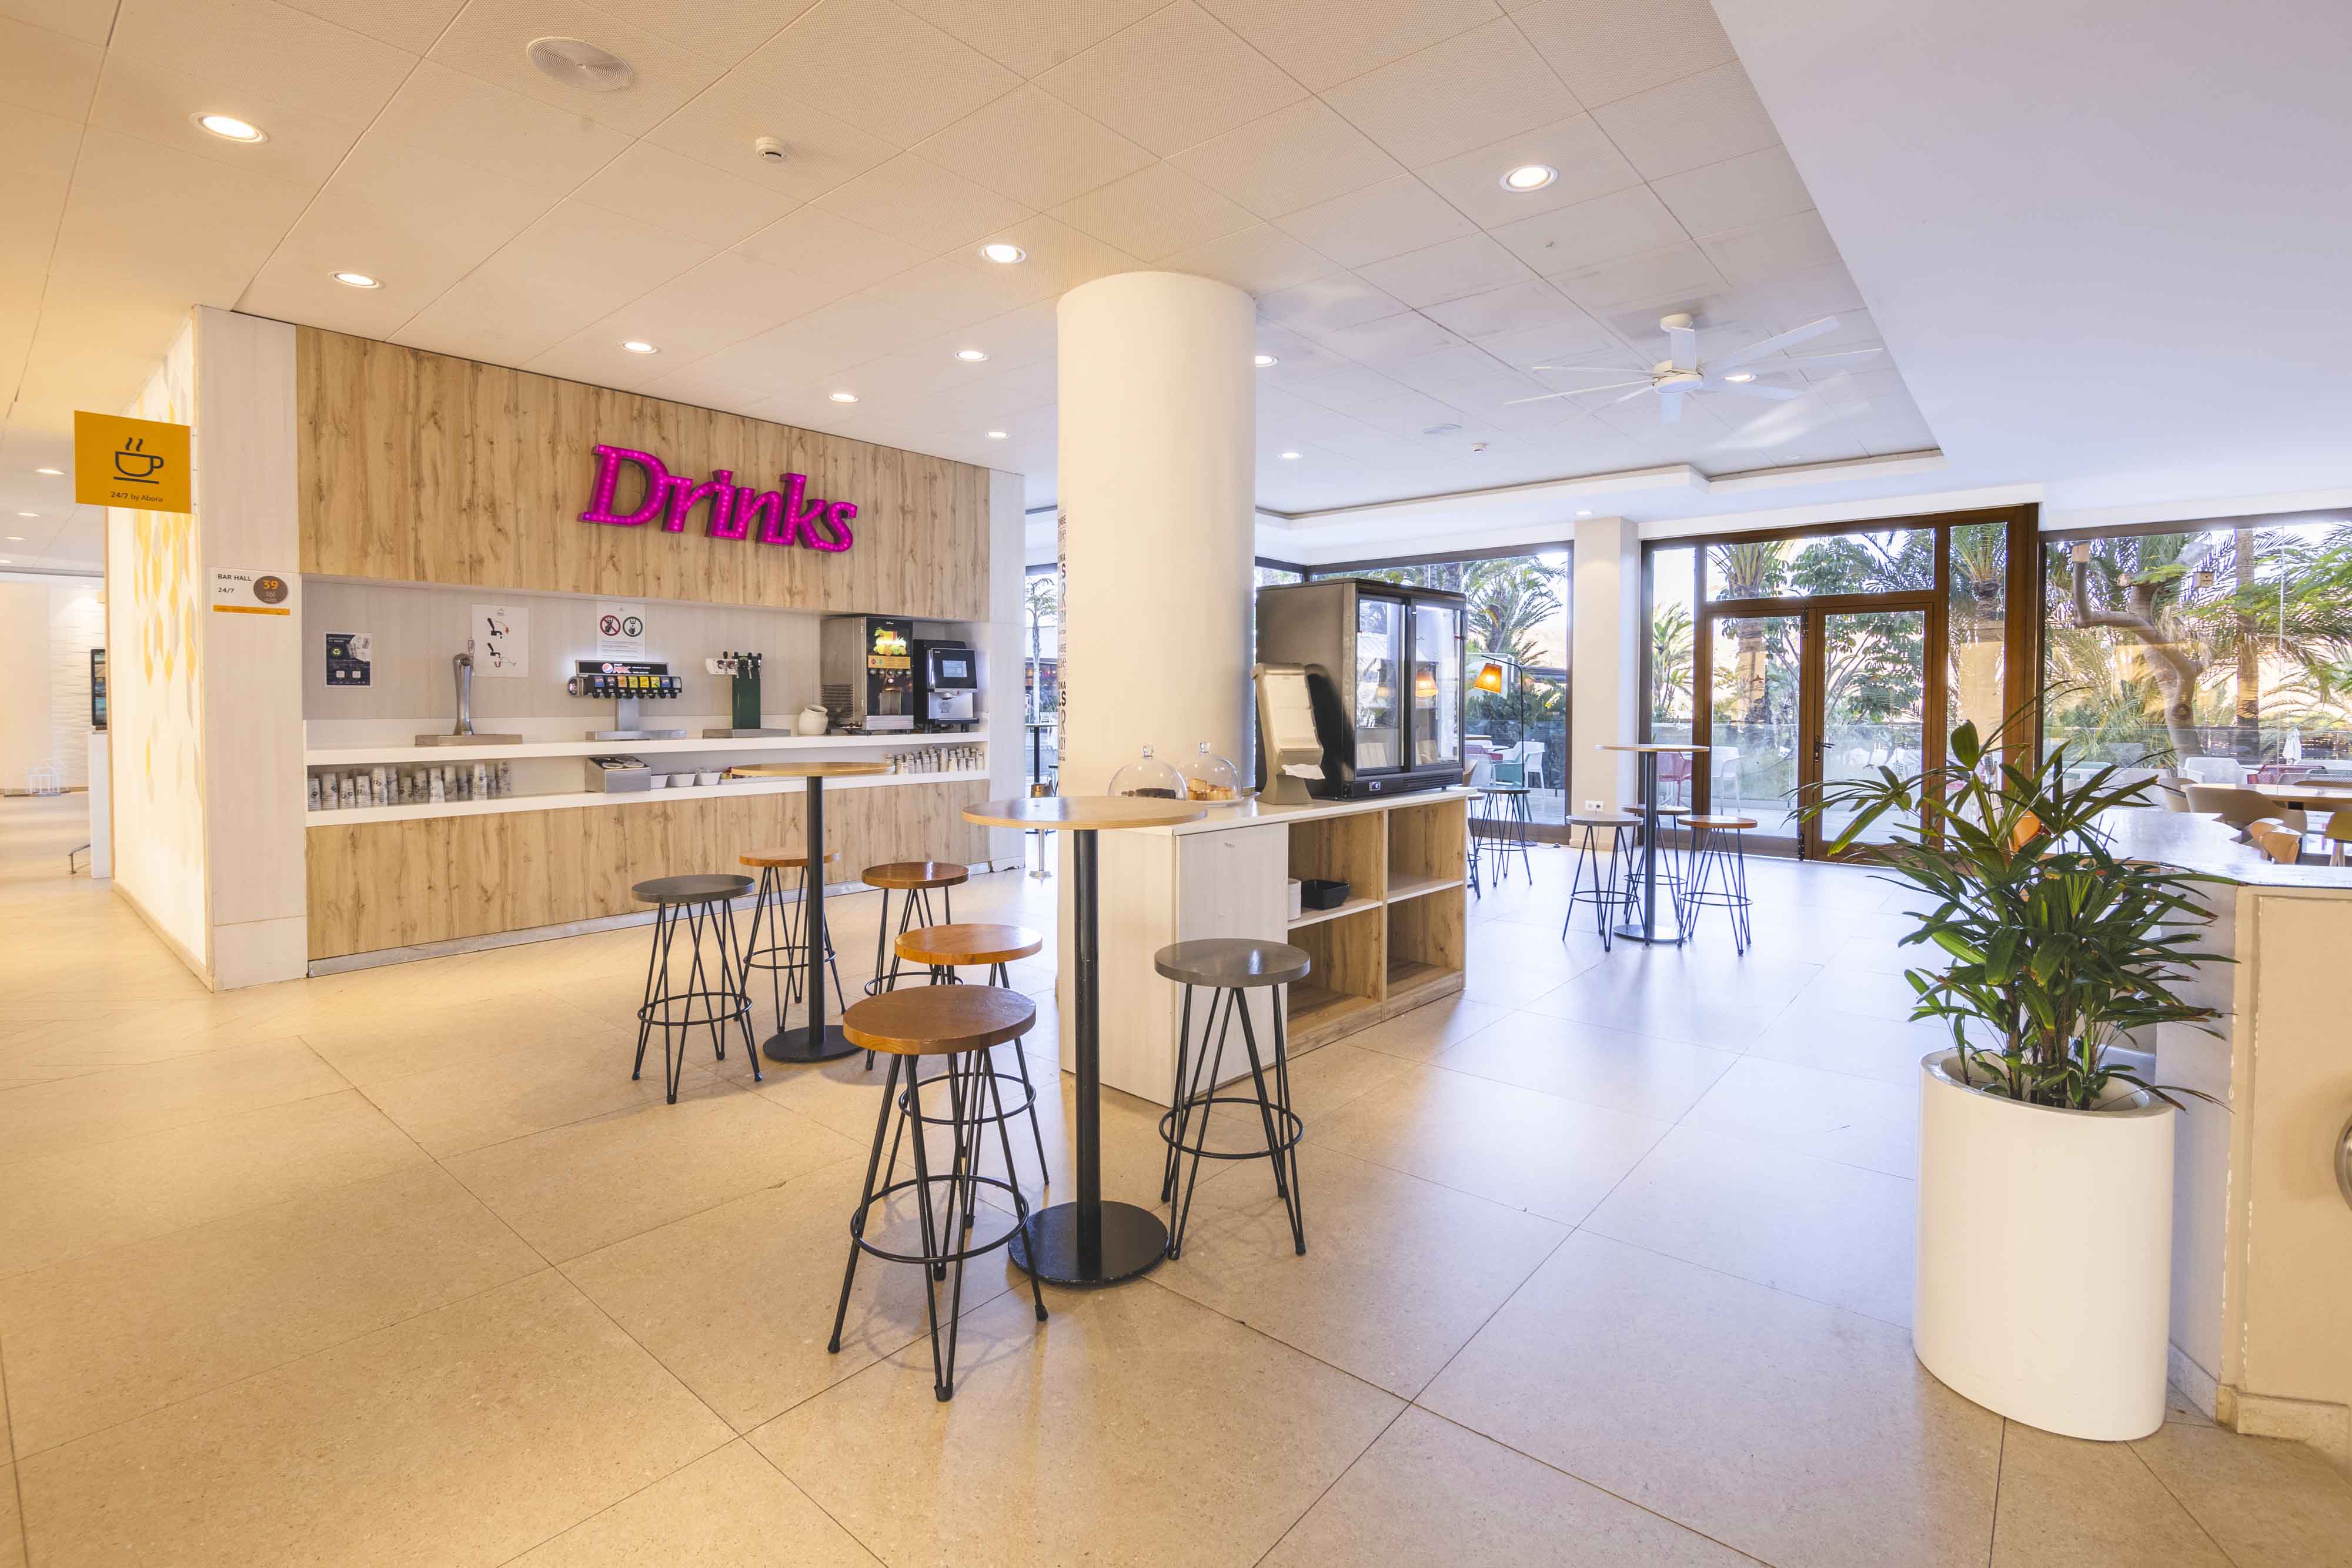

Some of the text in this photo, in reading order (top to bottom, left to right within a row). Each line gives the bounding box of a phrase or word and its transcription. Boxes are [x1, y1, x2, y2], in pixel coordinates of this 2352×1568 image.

[110, 491, 128, 499] 24/7
[577, 444, 857, 553] Drinks
[263, 580, 278, 590] 39
